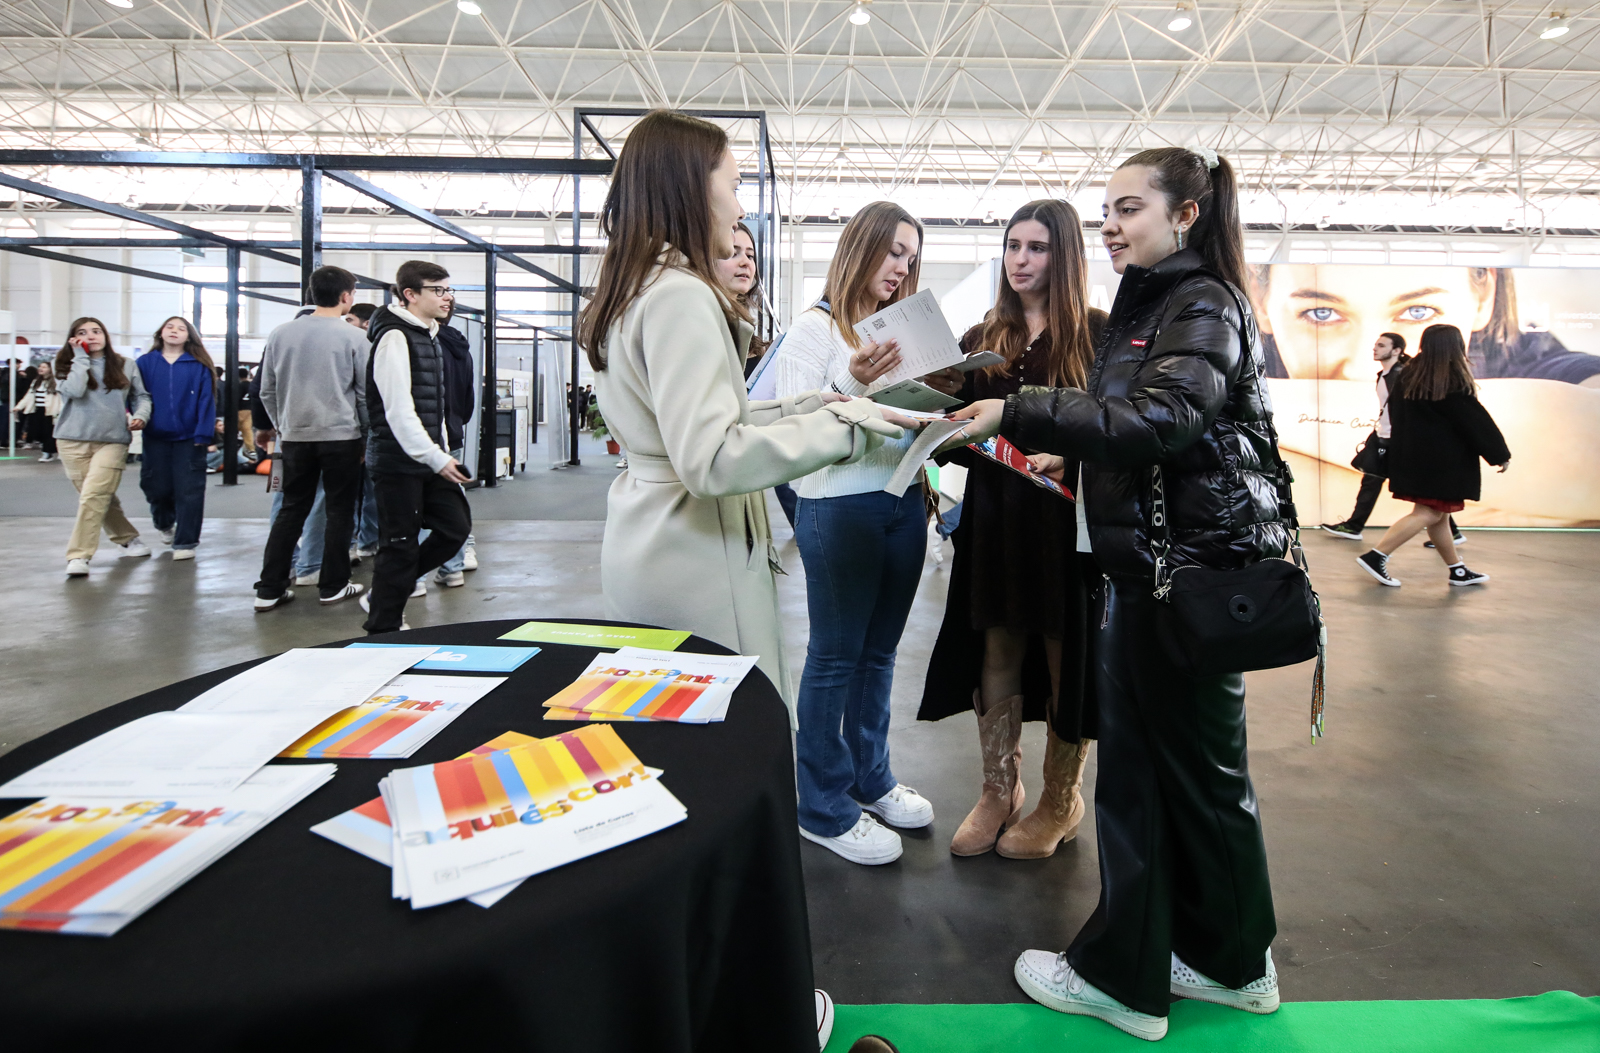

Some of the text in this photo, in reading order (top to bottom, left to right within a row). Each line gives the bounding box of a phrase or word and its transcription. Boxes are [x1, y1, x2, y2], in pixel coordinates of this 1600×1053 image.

[403, 764, 651, 847] aqui és cor!
